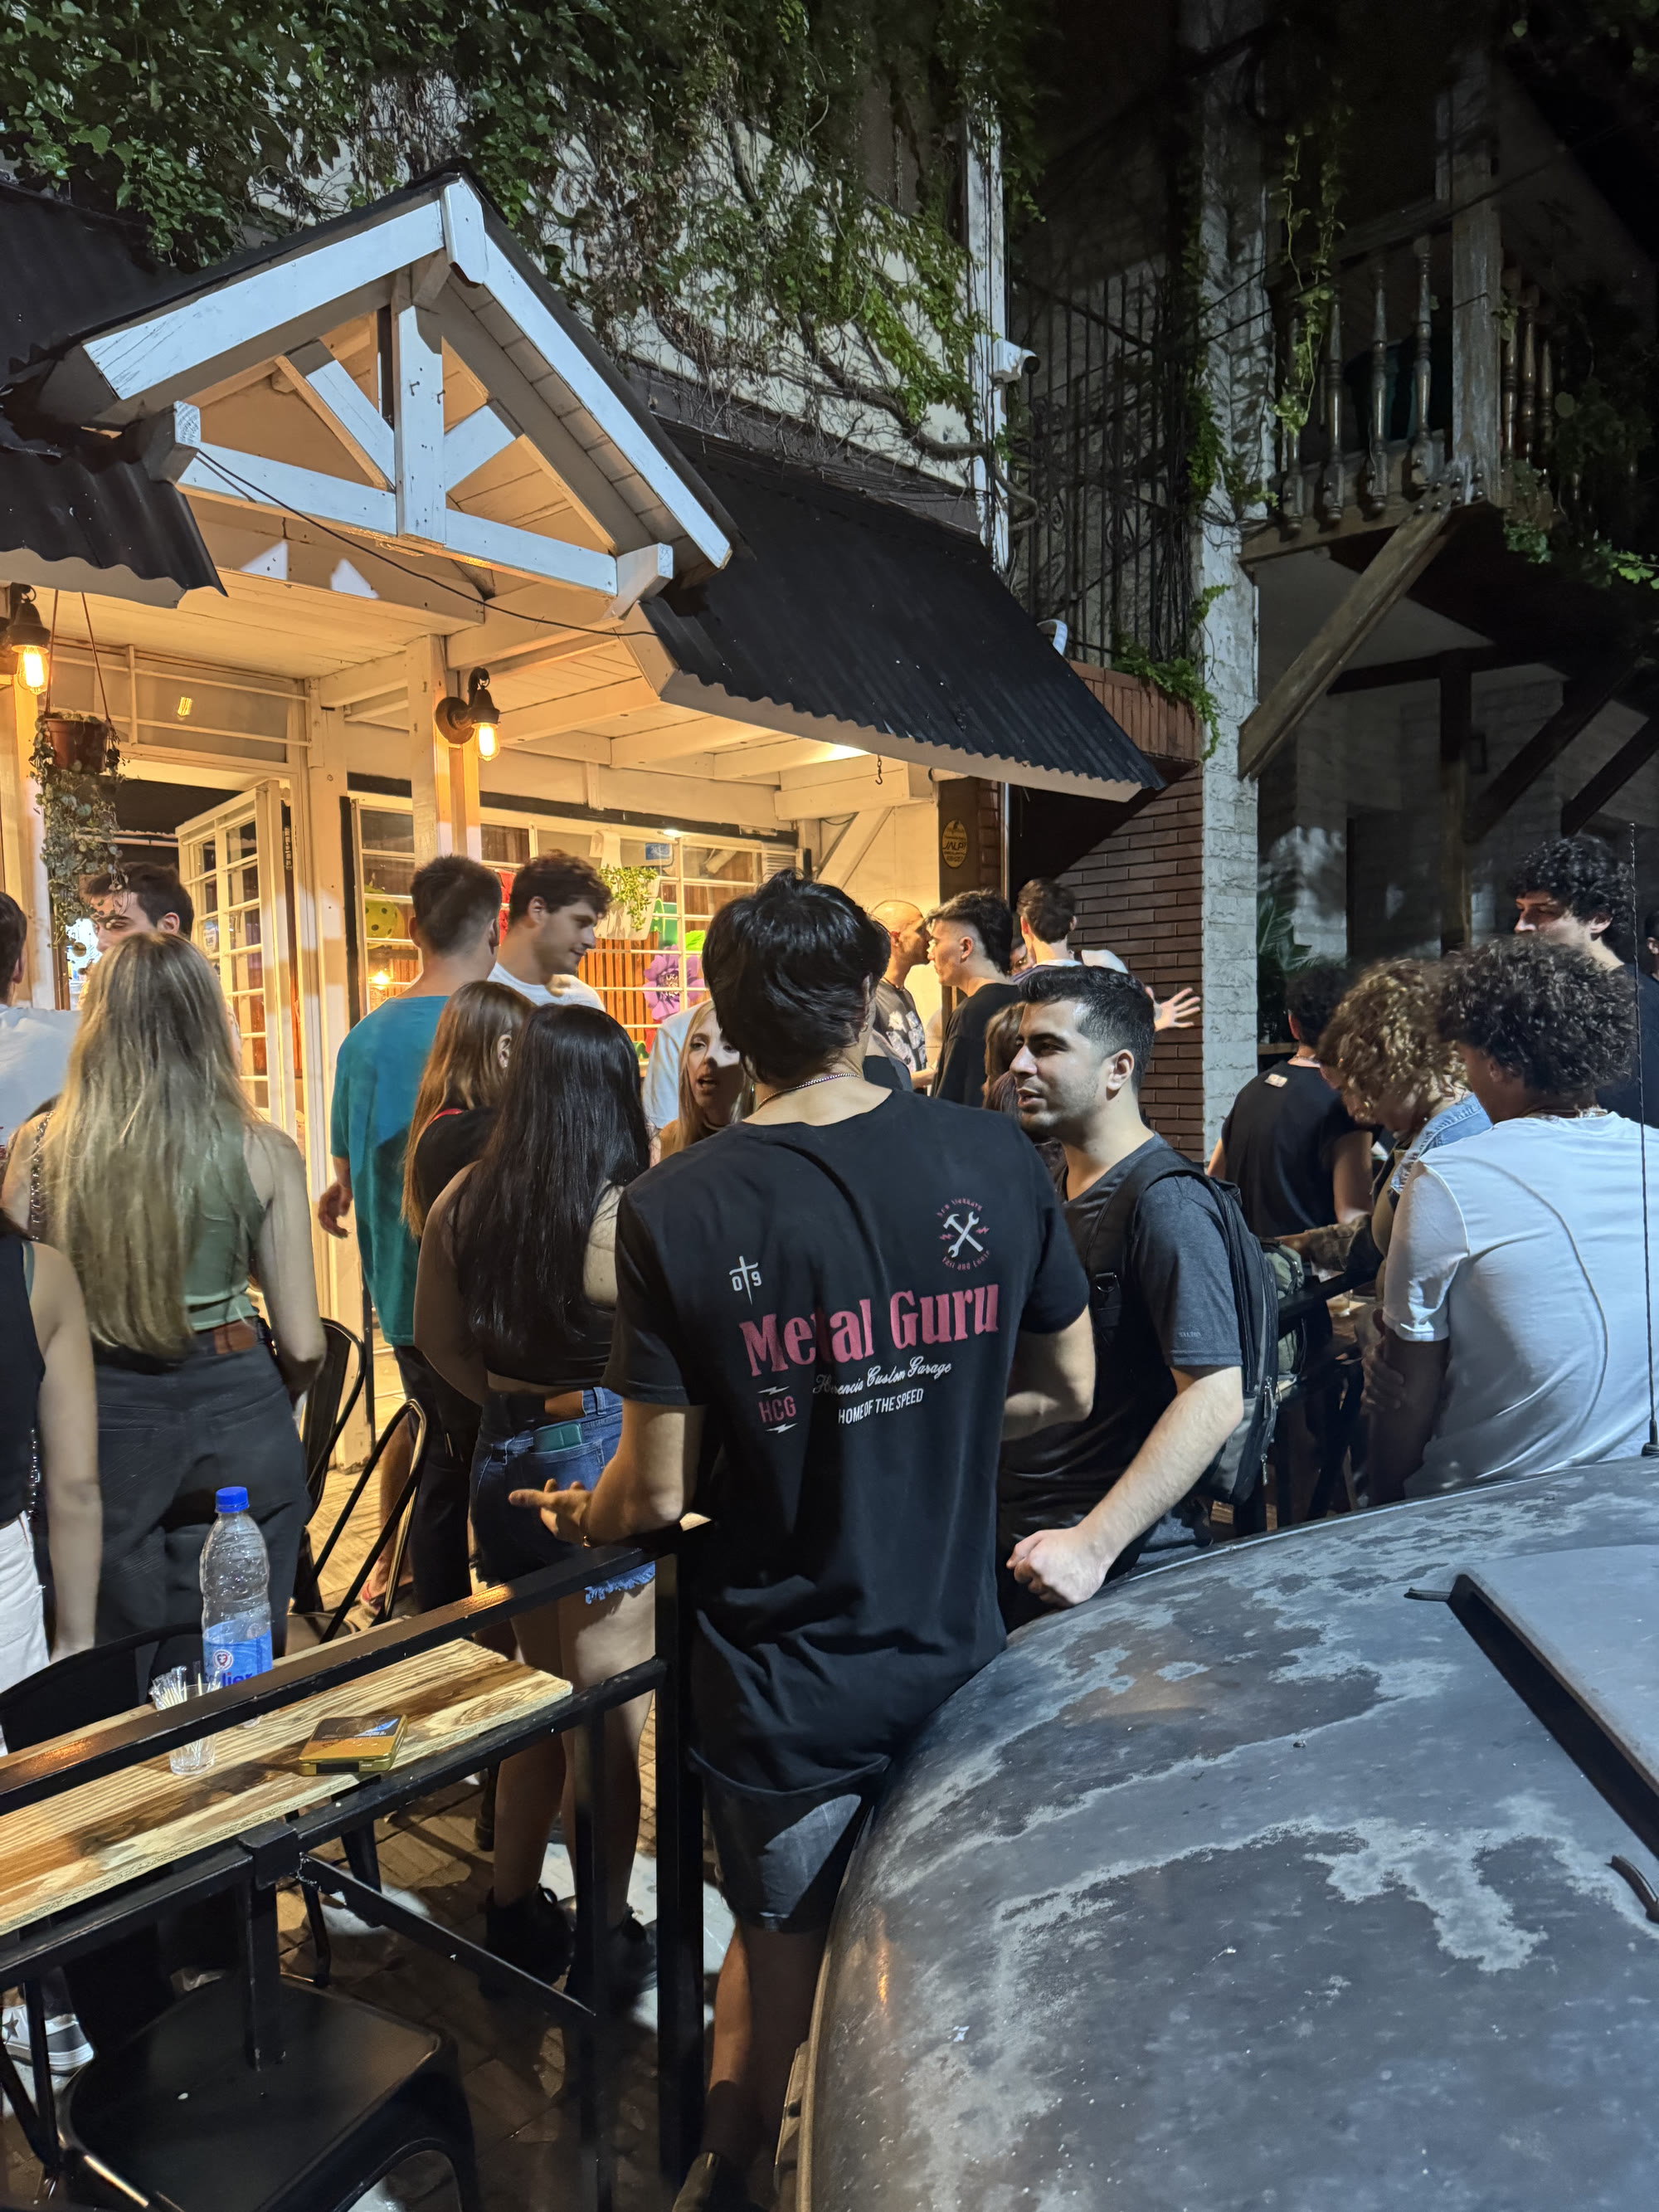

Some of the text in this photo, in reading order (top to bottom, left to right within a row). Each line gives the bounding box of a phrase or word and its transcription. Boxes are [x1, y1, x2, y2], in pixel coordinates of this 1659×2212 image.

[738, 1283, 1000, 1376] Metal Guru
[867, 1365, 906, 1386] Custom
[907, 1356, 952, 1380] Garage
[758, 1396, 796, 1424] HCG
[838, 1387, 924, 1425] HOME OF THE SPEED
